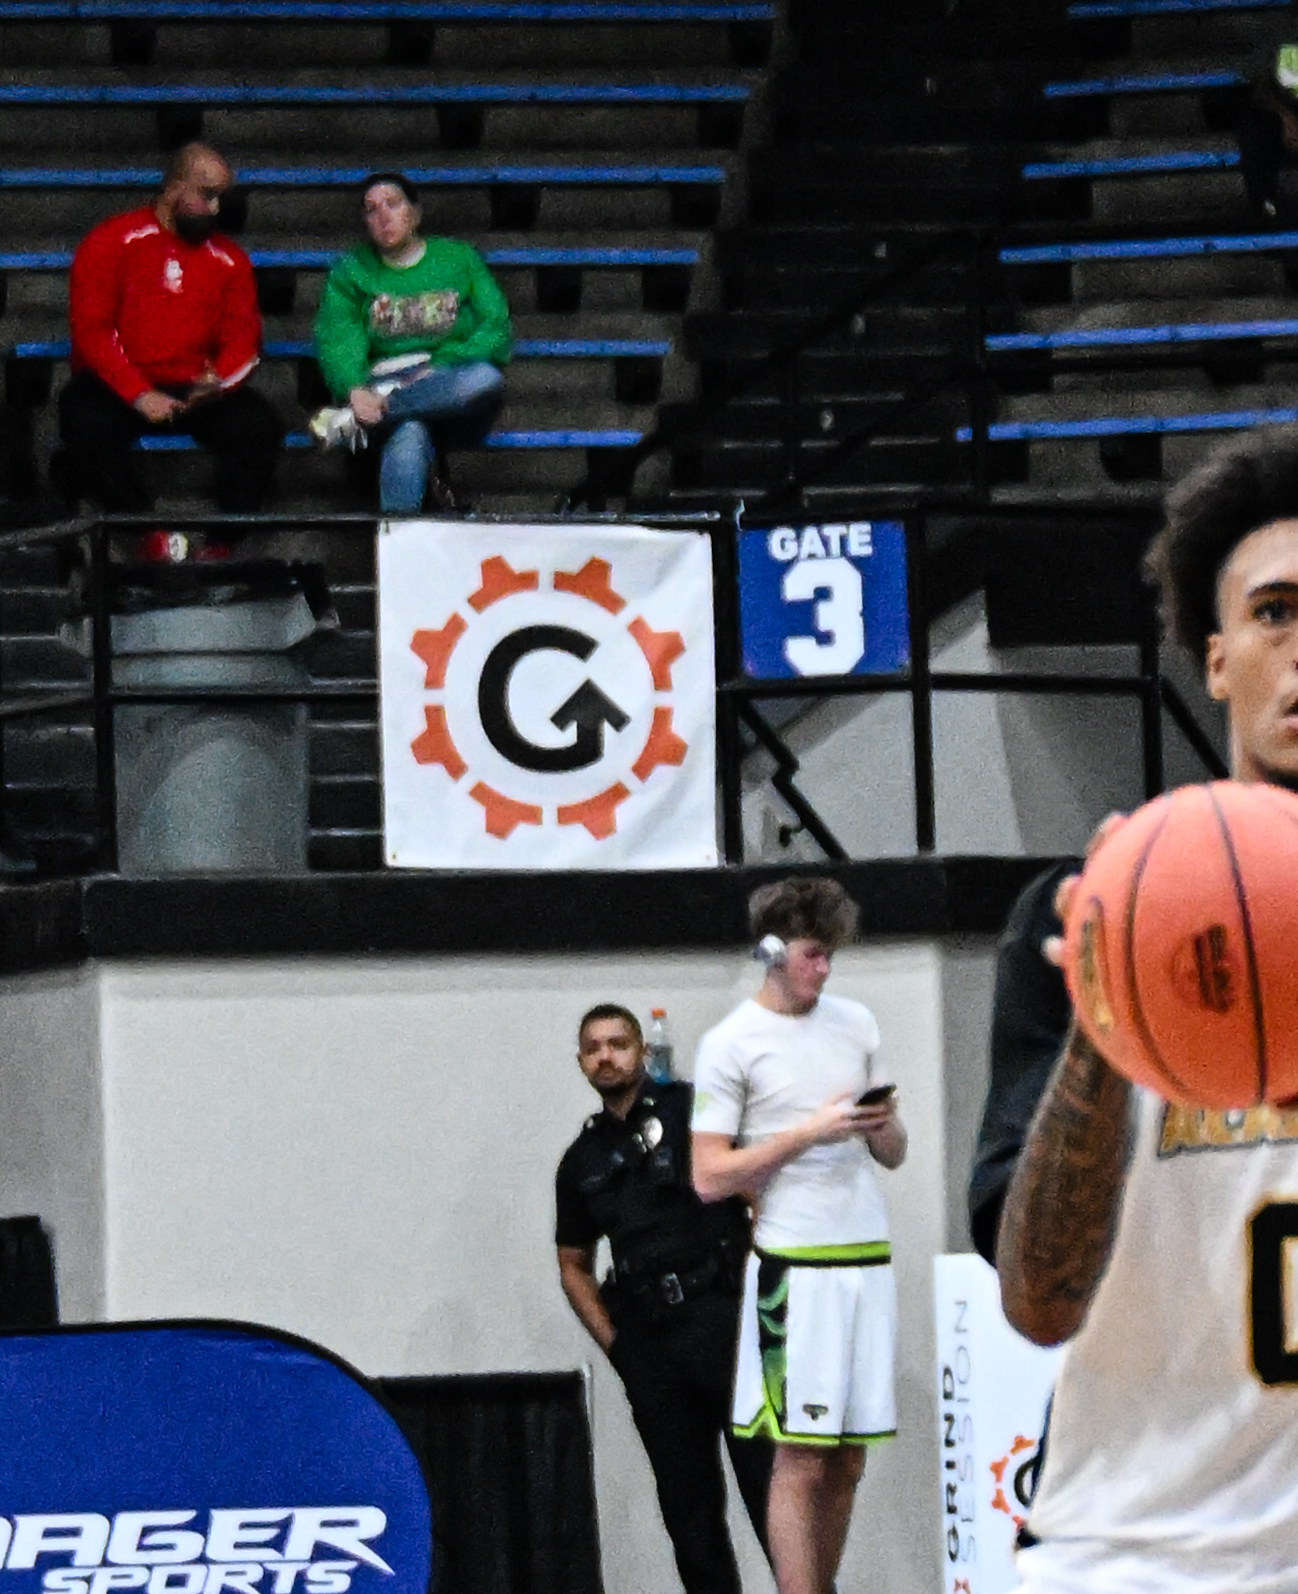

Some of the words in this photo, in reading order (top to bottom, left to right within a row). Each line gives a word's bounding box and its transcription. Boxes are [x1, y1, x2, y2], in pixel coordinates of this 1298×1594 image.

[768, 521, 873, 562] GATE
[782, 557, 866, 677] 3
[942, 1365, 960, 1563] GRIND
[954, 1300, 978, 1564] SESSION
[0, 1506, 395, 1576] AGER
